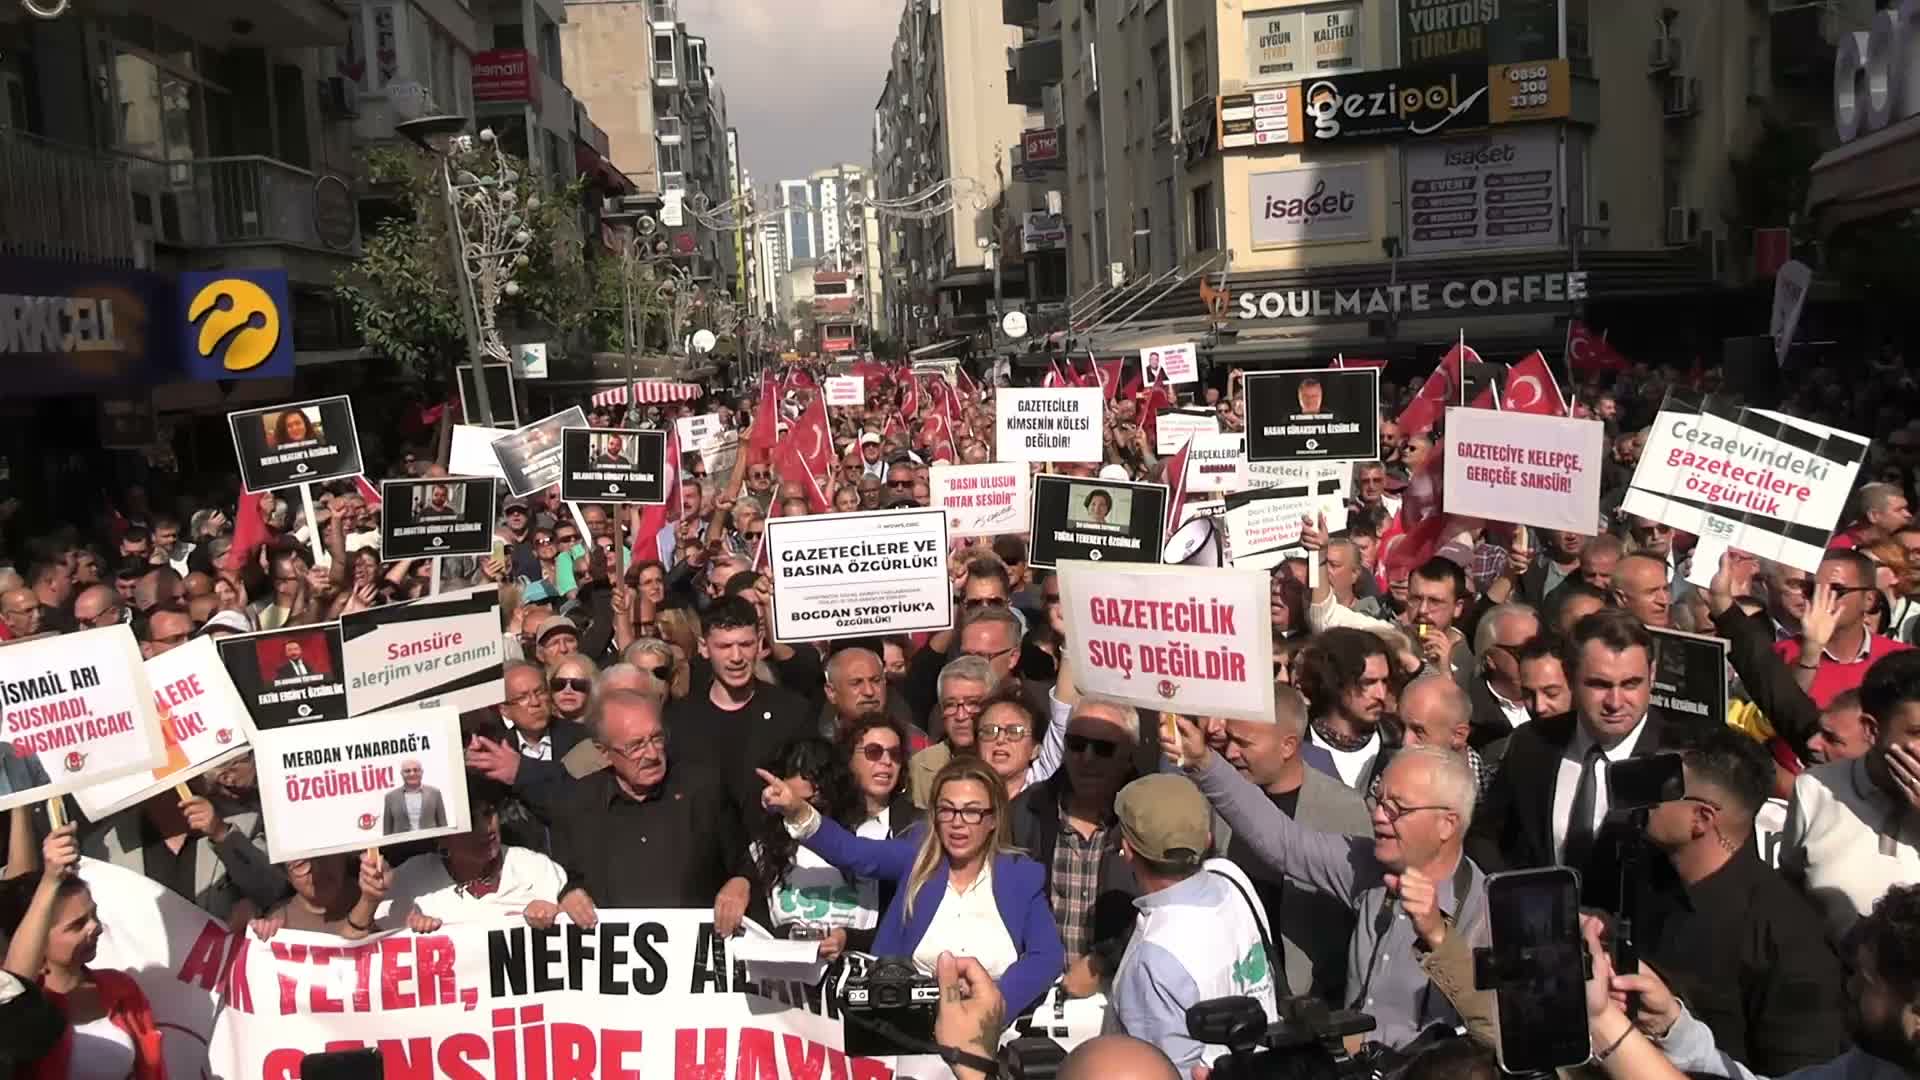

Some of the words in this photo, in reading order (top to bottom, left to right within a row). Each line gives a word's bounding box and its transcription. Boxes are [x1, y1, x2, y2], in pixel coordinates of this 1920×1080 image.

[1238, 283, 1429, 319] SOULMATE
[1442, 271, 1588, 307] COFFEE
[1018, 398, 1079, 412] GAZETECİLER
[1007, 416, 1054, 430] KİMSENİN
[1057, 416, 1089, 431] KÖLESİ
[1025, 433, 1071, 448] DEĞİLDİR!
[1458, 442, 1524, 465] GAZETECİYE
[1528, 450, 1583, 474] KELEPÇE,
[1671, 420, 1831, 481] Cezaevindeki
[980, 475, 1016, 489] ULUSUN
[1467, 466, 1516, 488] GERÇEĞE
[1521, 471, 1572, 493] SANSÜR!
[1666, 448, 1811, 502] gazetecilere
[1686, 473, 1780, 516] özgürlük
[782, 541, 909, 562] GAZETECİLERE
[914, 540, 937, 552] VE
[783, 564, 843, 577] BASINA
[848, 556, 937, 573] ÖZGÜRLÜK!
[791, 608, 851, 621] BOGDAN
[855, 602, 935, 617] SYROTİUK'A
[837, 617, 891, 627] ÖZGÜRLÜK!
[1090, 597, 1236, 635] GAZETECİLİK
[387, 630, 463, 660] Sansüre
[1088, 640, 1133, 679] SUÇ
[1140, 641, 1246, 682] DEĞİLDİR
[351, 665, 411, 690] alerjim
[414, 655, 441, 674] var
[443, 641, 496, 667] canım!
[2, 670, 66, 706] İSMAİL
[70, 666, 101, 689] ARI
[154, 673, 204, 711] LERE
[7, 697, 93, 732] SUSMADI,
[175, 712, 207, 742] ÜK!
[13, 711, 135, 757] SUSMAYACAK!
[283, 747, 341, 768] MERDAN
[345, 734, 430, 760] YANARDAĞ'A
[286, 765, 395, 802] ÖZGÜRLÜK!
[271, 934, 478, 1015] YETER,
[488, 921, 669, 998] NEFES
